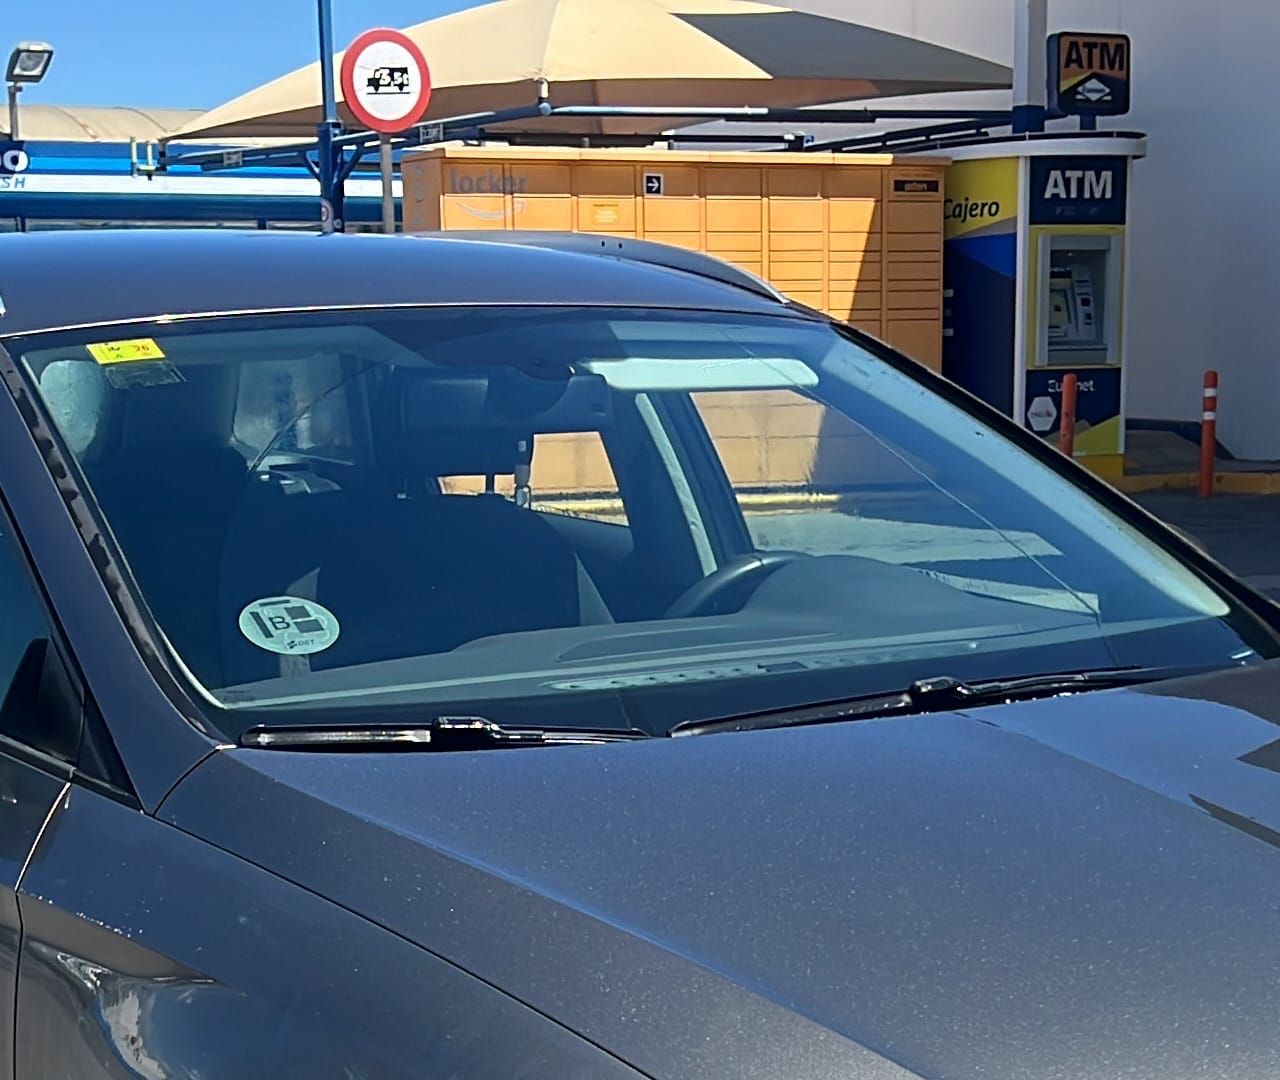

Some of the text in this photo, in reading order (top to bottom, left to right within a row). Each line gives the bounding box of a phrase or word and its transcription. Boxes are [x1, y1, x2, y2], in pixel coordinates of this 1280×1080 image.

[1064, 41, 1124, 71] ATM
[450, 167, 529, 193] locker
[1044, 170, 1113, 199] ATM
[943, 198, 1000, 223] Cajero
[269, 615, 290, 630] B
